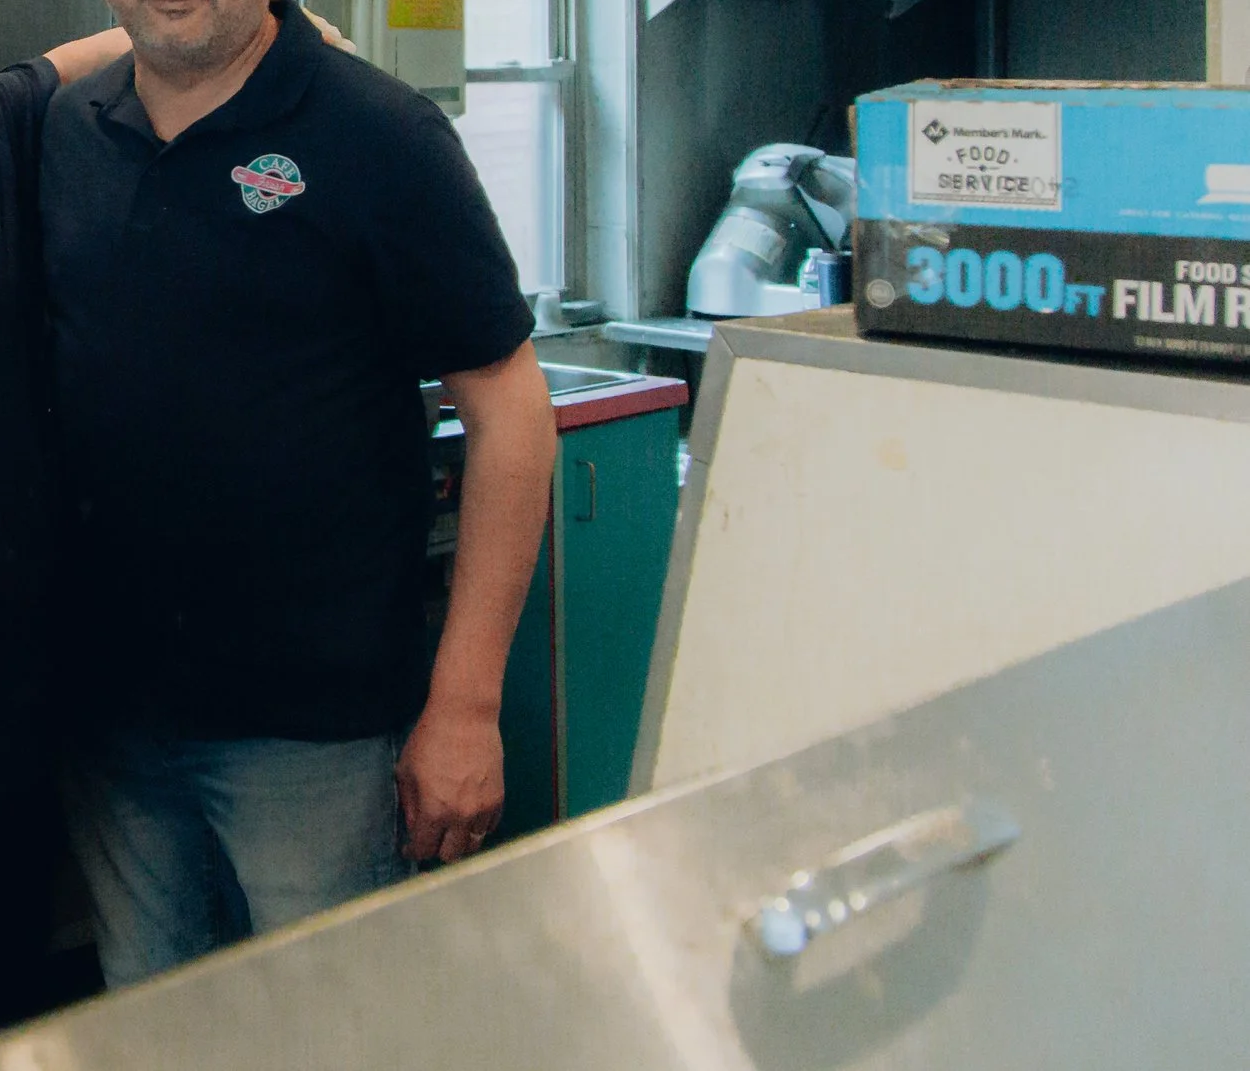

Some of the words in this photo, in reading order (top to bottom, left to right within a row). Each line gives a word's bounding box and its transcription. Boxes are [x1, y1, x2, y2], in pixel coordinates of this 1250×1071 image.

[953, 127, 1009, 139] Member's
[955, 145, 1011, 166] FOOD
[258, 158, 297, 179] CAFE
[938, 173, 1030, 193] SERVICE
[245, 189, 284, 211] BAGEL
[1175, 260, 1237, 285] FOOD
[1113, 279, 1216, 327] FILM
